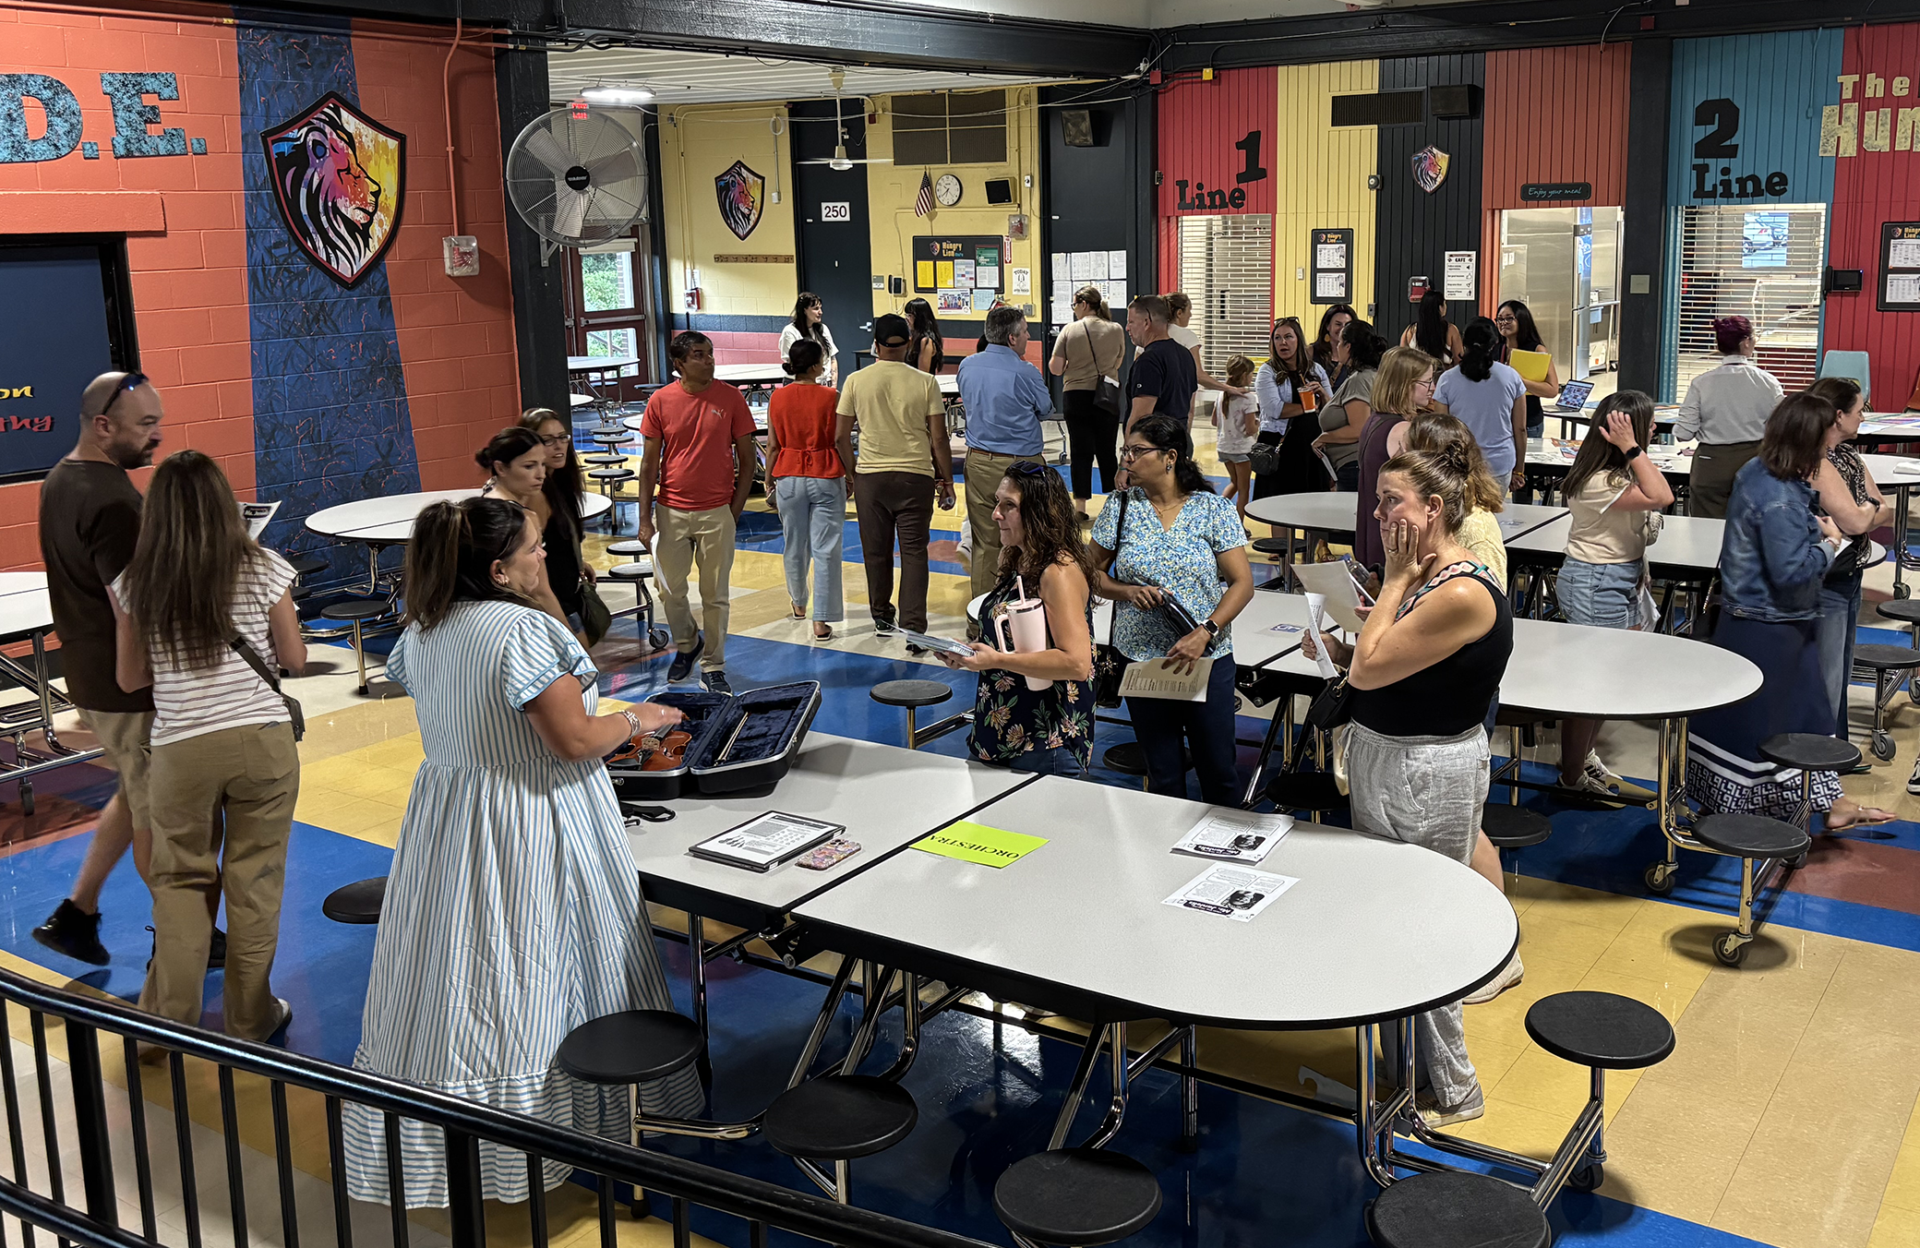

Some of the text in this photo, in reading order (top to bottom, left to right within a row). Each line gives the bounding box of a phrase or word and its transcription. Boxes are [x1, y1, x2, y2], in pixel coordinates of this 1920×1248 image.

[1837, 73, 1910, 99] The
[1694, 98, 1740, 159] 2
[1176, 130, 1267, 210] Line 1
[1692, 163, 1788, 199] Line
[1528, 186, 1582, 199] Enjoy your meal
[824, 205, 847, 218] 250
[930, 835, 1019, 859] ORCHESTRA
